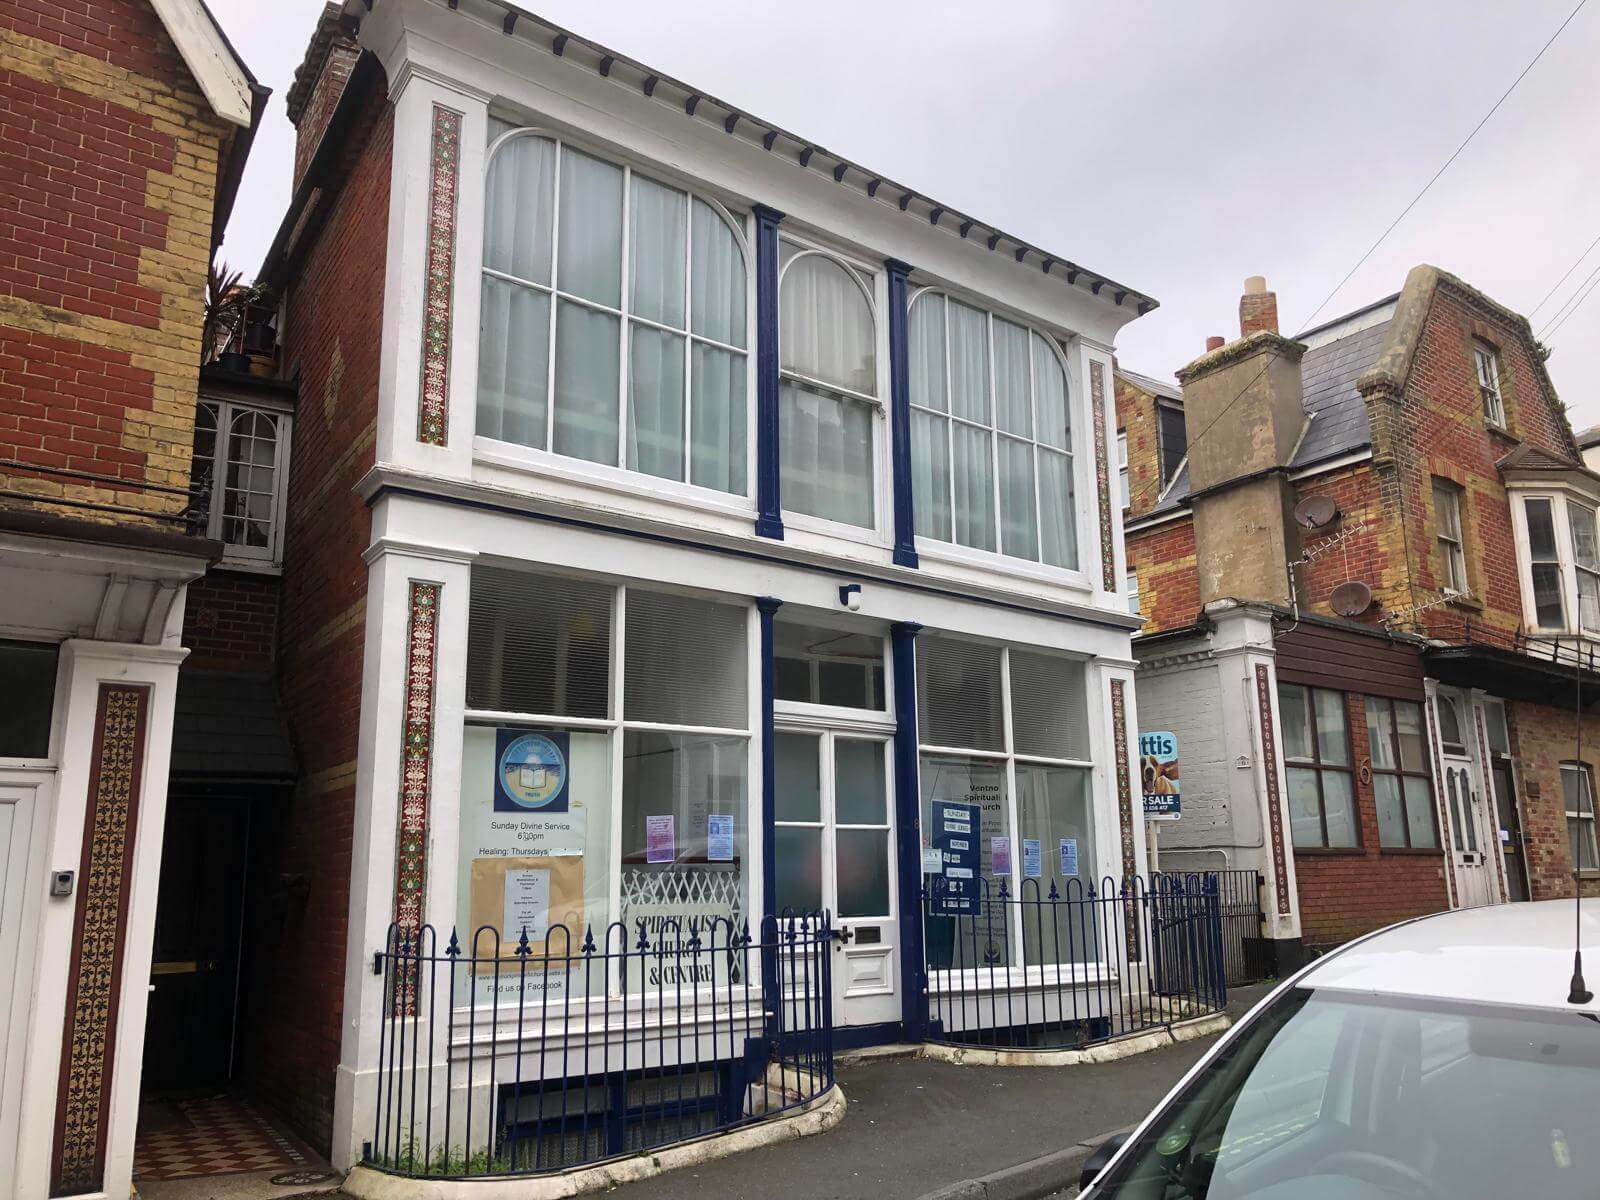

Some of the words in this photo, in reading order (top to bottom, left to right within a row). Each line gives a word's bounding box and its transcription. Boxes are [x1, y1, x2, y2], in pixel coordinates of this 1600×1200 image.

[1138, 735, 1173, 756] ittis
[963, 793, 1008, 803] Spiritualit
[1148, 796, 1174, 805] SALE
[982, 803, 1001, 811] urch
[491, 821, 519, 831] Sunday
[520, 822, 543, 830] Divine
[544, 822, 570, 830] Service
[478, 847, 509, 857] Healing:
[652, 939, 701, 960] CHRCH
[649, 966, 660, 985] &
[527, 981, 562, 991] Faceook
